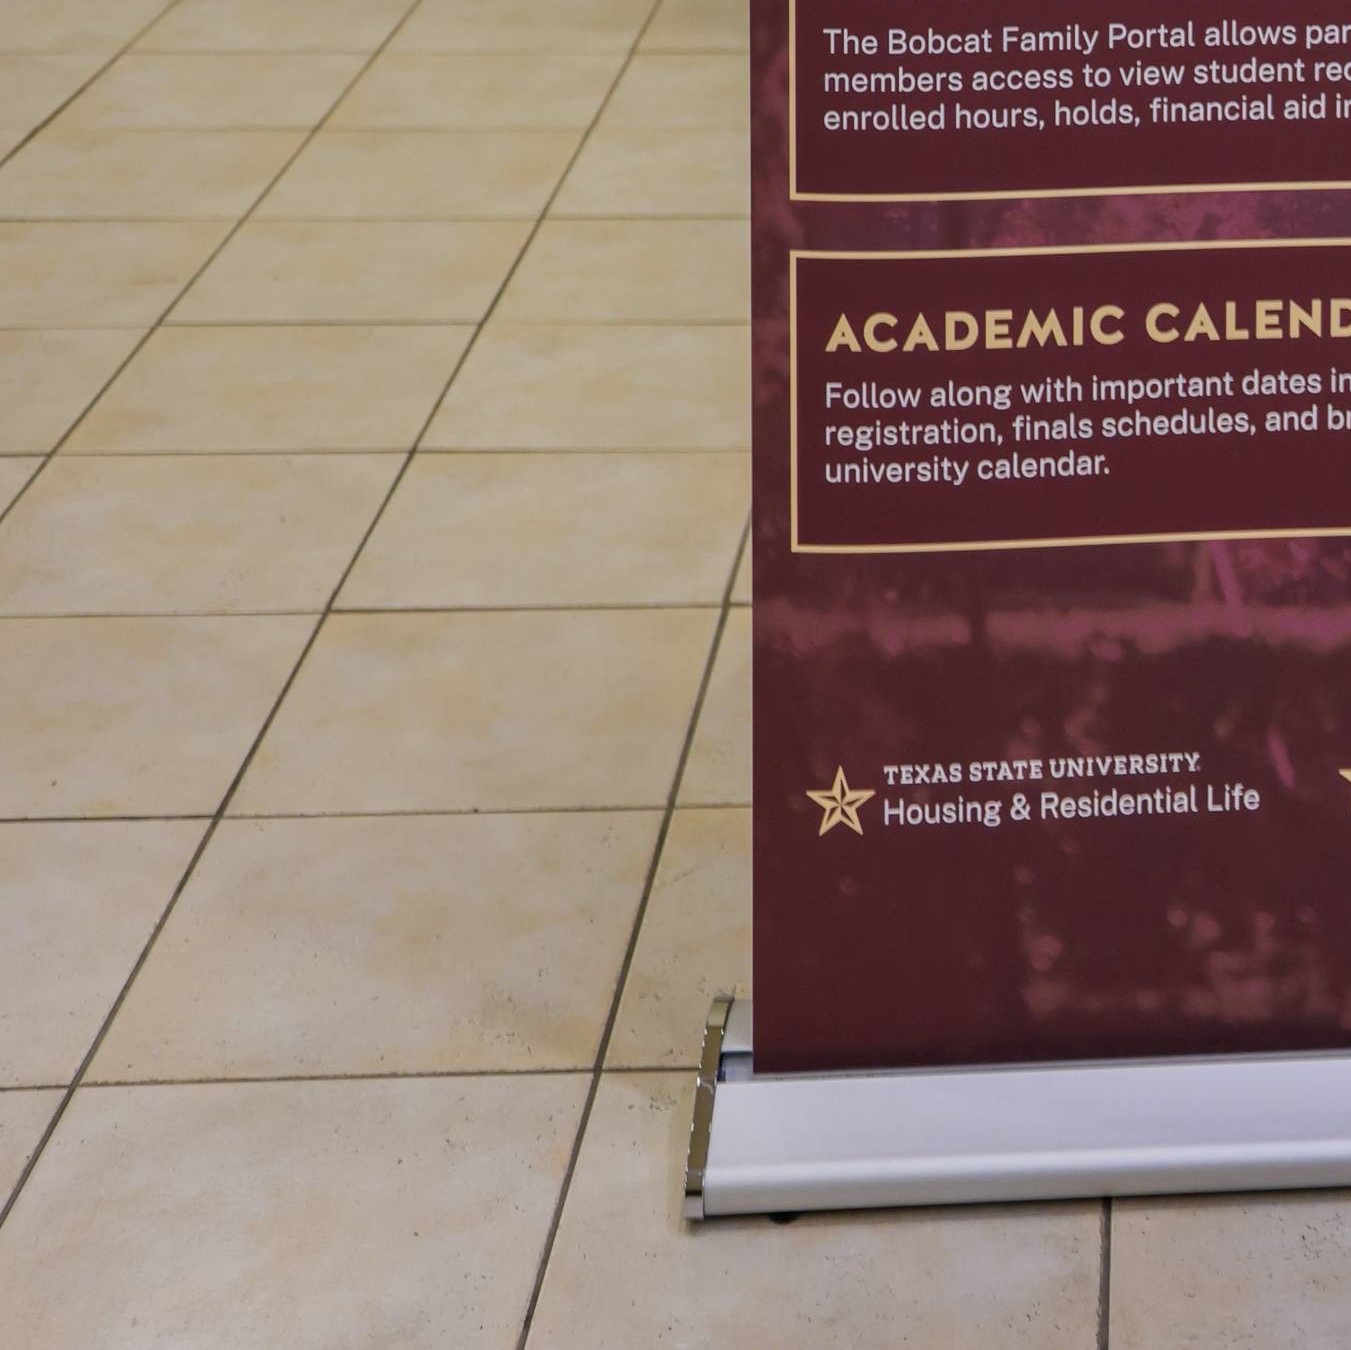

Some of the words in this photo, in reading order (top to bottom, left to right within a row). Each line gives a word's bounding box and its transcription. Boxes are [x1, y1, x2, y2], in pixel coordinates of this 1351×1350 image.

[822, 27, 878, 56] The
[888, 27, 993, 55] Bobcat
[1002, 23, 1099, 56] Family
[1108, 19, 1196, 50] Portal
[1204, 19, 1297, 48] allows
[824, 65, 963, 94] members
[971, 67, 1074, 92] access
[1082, 63, 1112, 89] to
[1119, 59, 1186, 87] view
[1193, 55, 1306, 85] student
[823, 102, 945, 132] enrolled
[955, 102, 1045, 132] hours,
[1054, 96, 1141, 128] holds,
[1149, 93, 1275, 124] financial
[1283, 92, 1326, 120] aid
[825, 304, 1125, 354] ACADEMIC
[825, 381, 922, 410] Follow
[930, 379, 1013, 411] along
[1020, 374, 1083, 405] with
[1092, 371, 1234, 405] important
[1241, 367, 1322, 397] dates
[825, 417, 1003, 452] registration,
[1011, 412, 1094, 442] finals
[1101, 406, 1257, 439] schedules,
[1264, 402, 1318, 433] and
[825, 454, 970, 487] university
[977, 448, 1110, 481] calendar.
[883, 762, 963, 786] TEXAS
[969, 758, 1043, 783] STATE
[1048, 751, 1201, 780] UNIVERSITY
[884, 794, 1003, 828] Housing
[1009, 792, 1031, 821] &
[1040, 784, 1199, 820] Residential
[1207, 782, 1260, 813] Life
